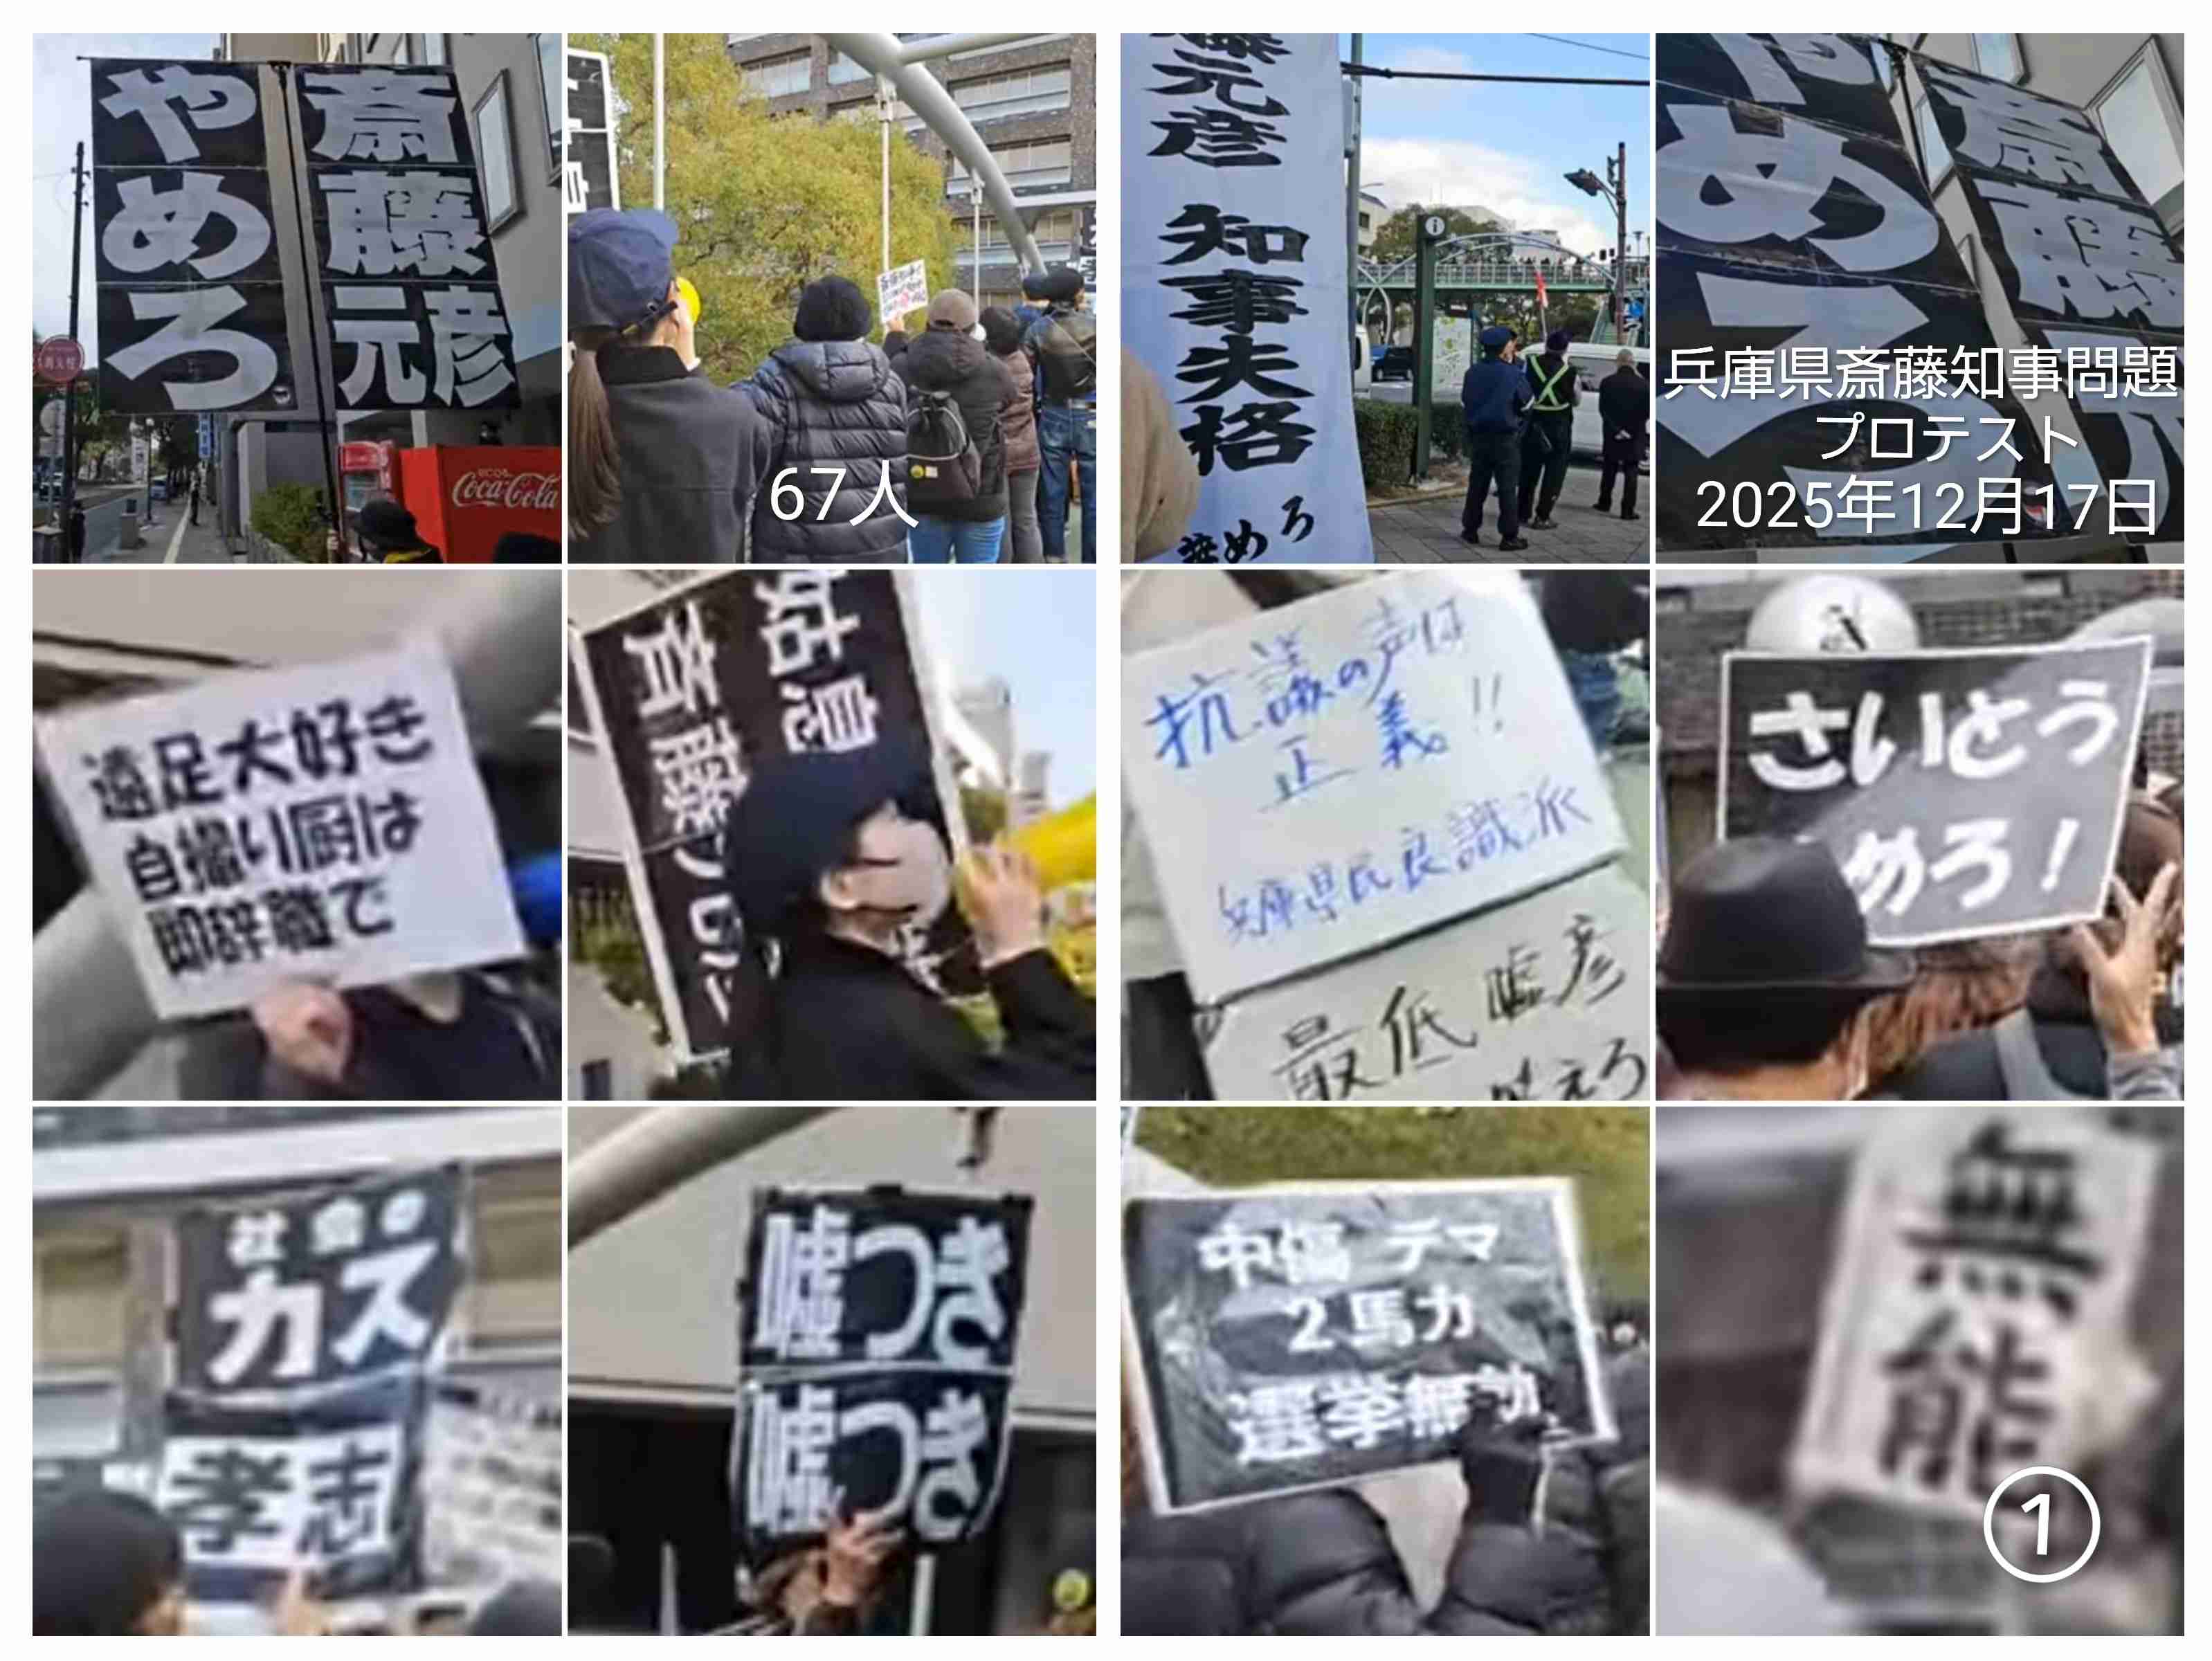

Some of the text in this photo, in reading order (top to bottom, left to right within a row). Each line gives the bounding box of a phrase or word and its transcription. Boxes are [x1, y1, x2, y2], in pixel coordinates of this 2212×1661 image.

[98, 64, 278, 410] やめろ
[1159, 204, 1315, 476] 知事失格
[452, 471, 559, 509] Coca-Cola
[82, 695, 433, 822] 遠足大好き
[1748, 680, 2119, 790] さいとう
[1827, 818, 2080, 917] めろ！
[206, 1240, 439, 1383] カス
